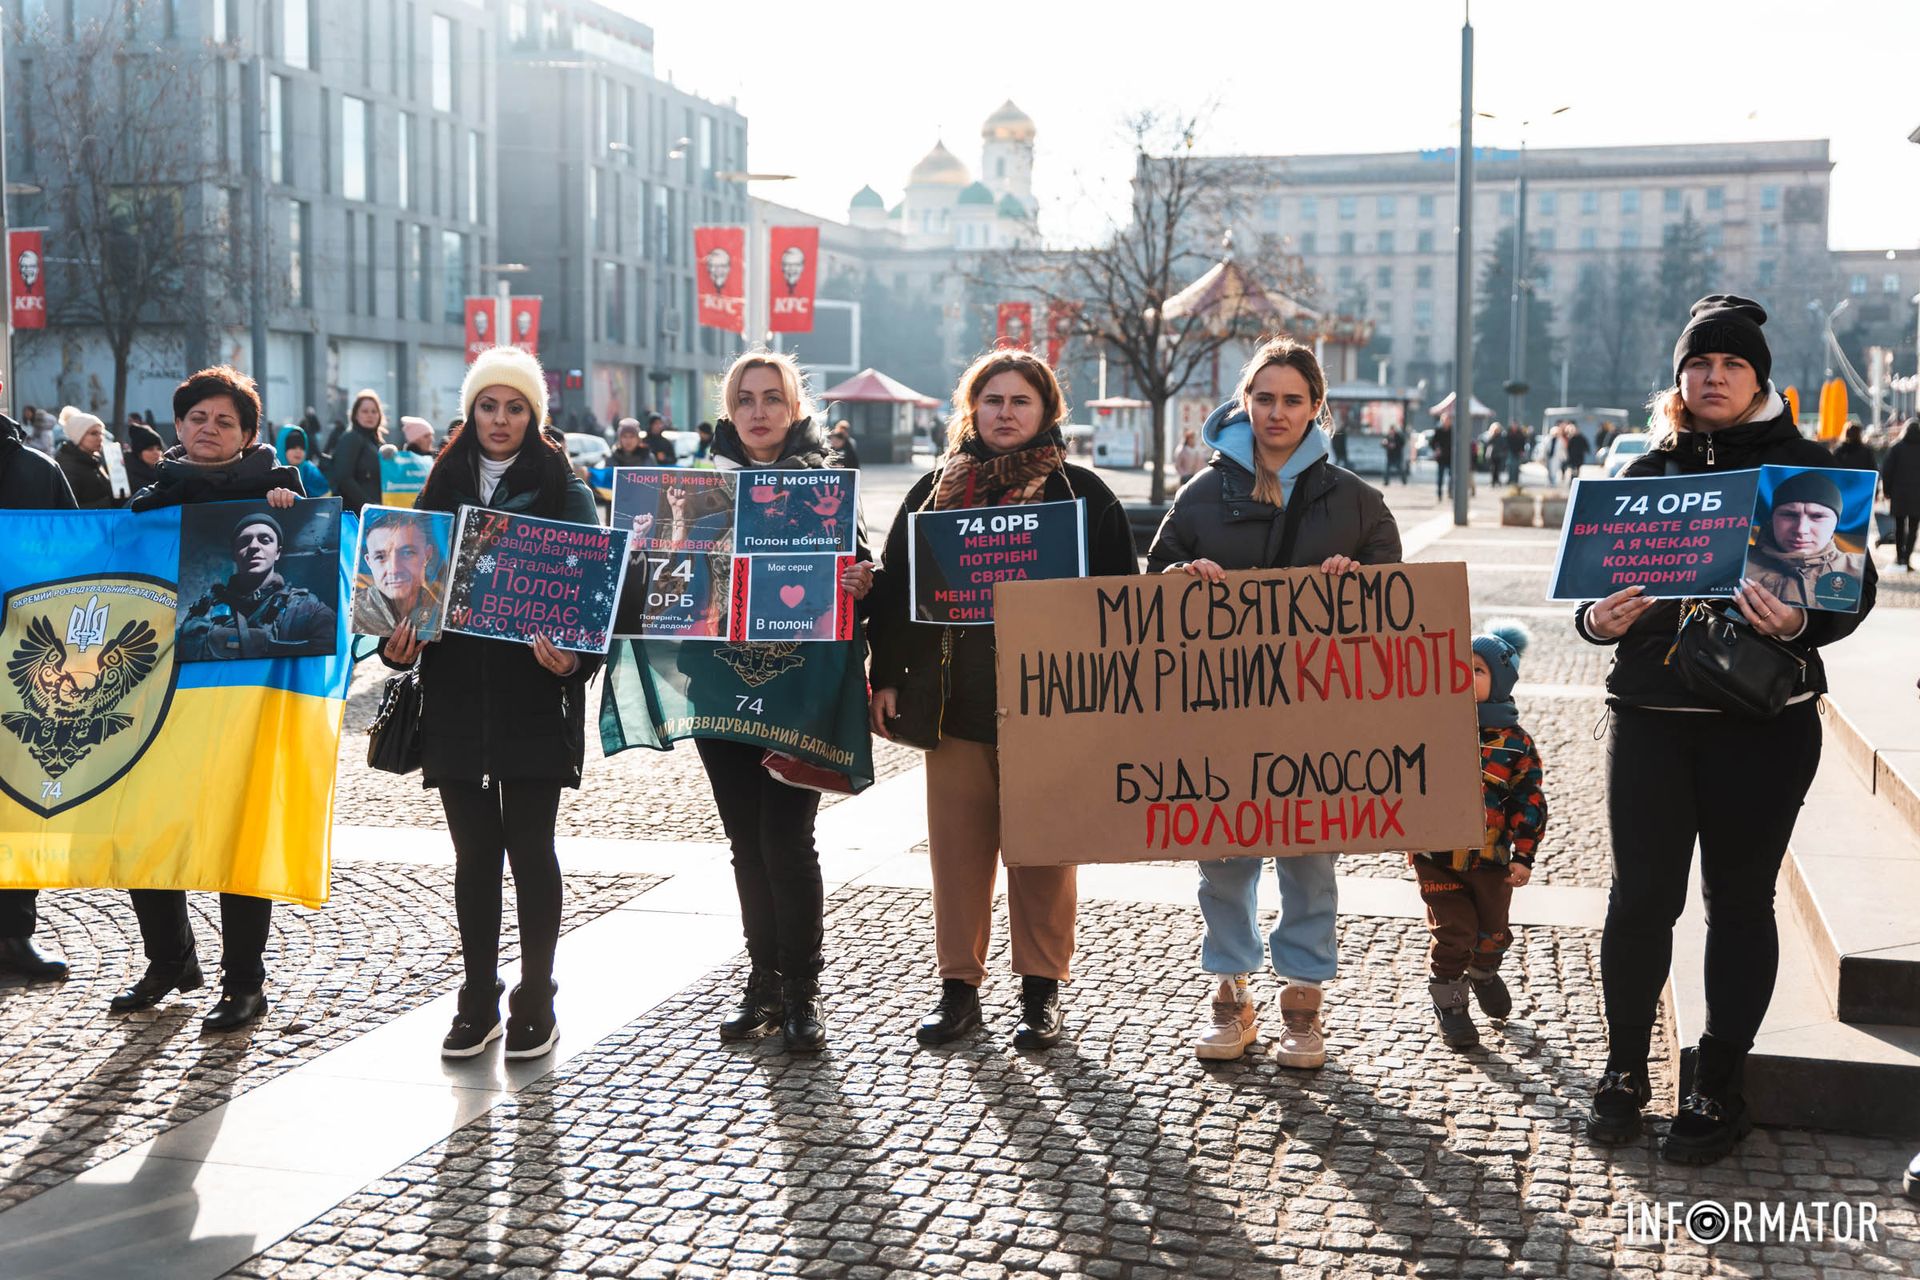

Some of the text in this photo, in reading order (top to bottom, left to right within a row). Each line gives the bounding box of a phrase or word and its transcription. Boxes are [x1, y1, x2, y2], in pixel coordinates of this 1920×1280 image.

[15, 295, 44, 310] KFC
[704, 294, 737, 315] KFC
[774, 297, 809, 313] KFC
[628, 473, 727, 487] Поки Ви живете
[754, 475, 840, 486] Не мовчи
[1614, 491, 1723, 516] 74 ОРБ
[483, 513, 611, 550] 74 окремий
[956, 513, 1039, 536] 74 ОРБ
[1573, 516, 1749, 536] ВИ ЧЕКАЄТЕ СВЯТА
[479, 529, 609, 562] Розвідувальний
[745, 535, 842, 547] Полон вбиває
[964, 532, 1032, 548] МЕНІ НЕ
[1612, 535, 1710, 551] А Я ЧЕКАЮ
[496, 552, 584, 578] Батальйон
[959, 549, 1038, 567] ПОТРІБНІ
[1603, 553, 1713, 568] КОХАНОГО З
[647, 558, 694, 582] 74
[767, 563, 813, 575] Моє серце
[970, 567, 1027, 584] СВЯТА
[1612, 570, 1697, 585] ПОЛОНУ!!
[491, 566, 581, 601] Полон
[12, 584, 178, 609] ОКРЕМИЙ РОЗВІДУВАЛЬНИЙ БАТАЛЬЙОН
[648, 592, 694, 608] ОРБ
[934, 590, 976, 602] МЕНІ
[482, 593, 580, 627] ВБИВАЄ
[640, 613, 682, 622] Поверніть
[948, 607, 985, 620] СИН
[1097, 583, 1165, 648] МИ
[452, 607, 607, 647] Мого чоловіка
[660, 622, 692, 631] додому
[756, 618, 813, 630] В полоні
[1020, 648, 1144, 717] НАШИХ
[1296, 629, 1473, 702] КАТУЮТЬ
[735, 694, 764, 715] 74
[677, 715, 798, 746] РОЗВІДУВАЛЬНИЙ
[1116, 743, 1427, 803] БУДЬ ГОЛОСОМ
[40, 780, 63, 800] 74
[1145, 795, 1406, 850] ПОЛОНЕНИХ
